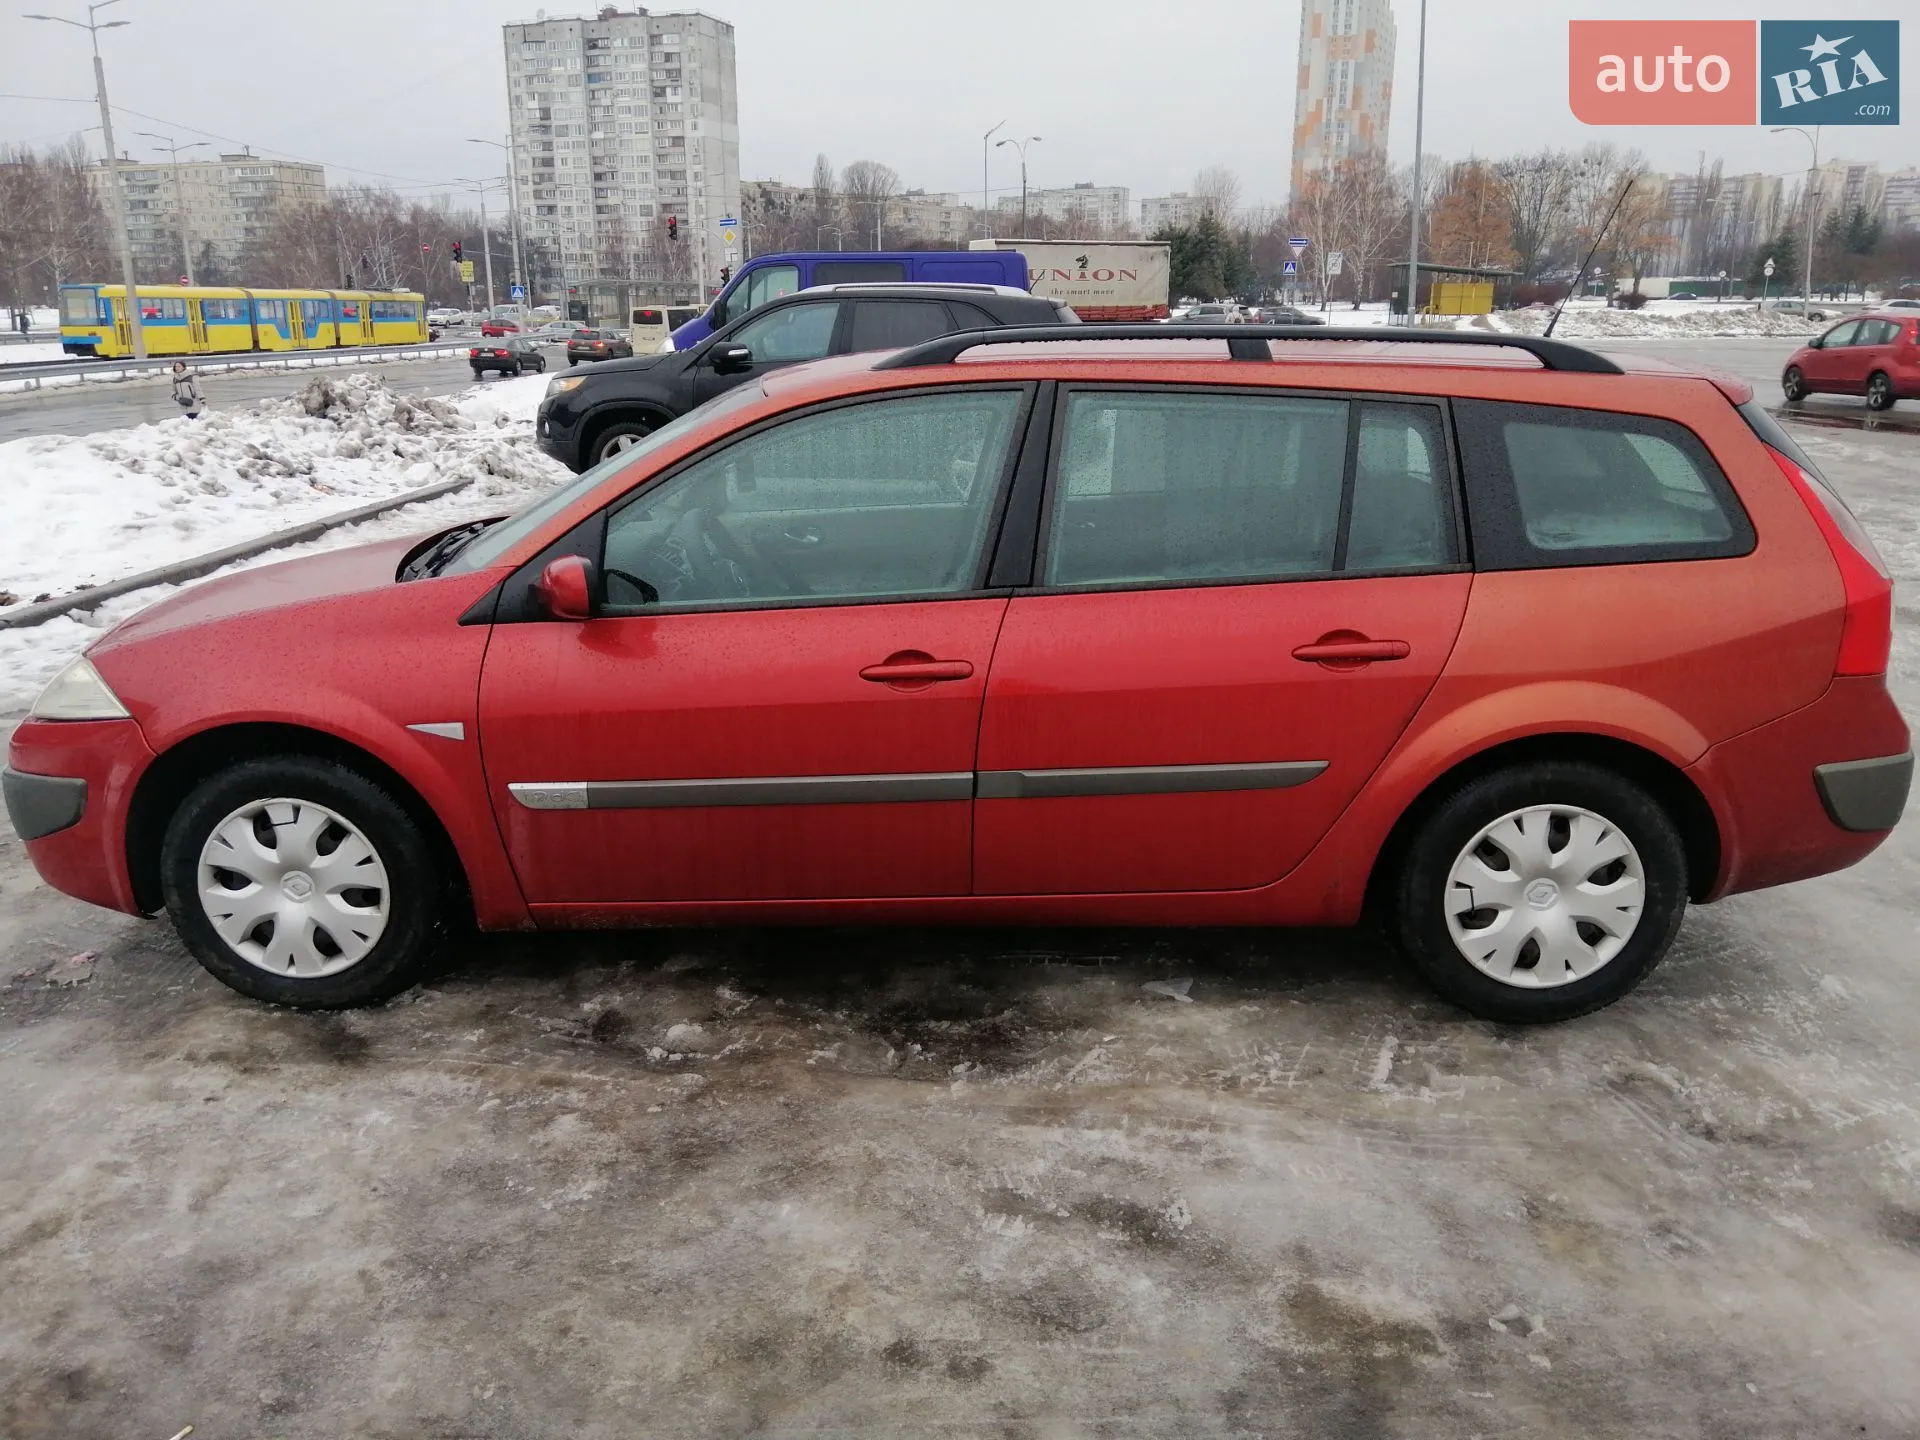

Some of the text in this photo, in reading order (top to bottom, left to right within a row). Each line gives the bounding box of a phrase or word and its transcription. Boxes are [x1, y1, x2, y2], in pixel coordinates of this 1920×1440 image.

[1028, 268, 1138, 282] UNION
[1050, 288, 1064, 296] the
[1066, 288, 1091, 296] smart
